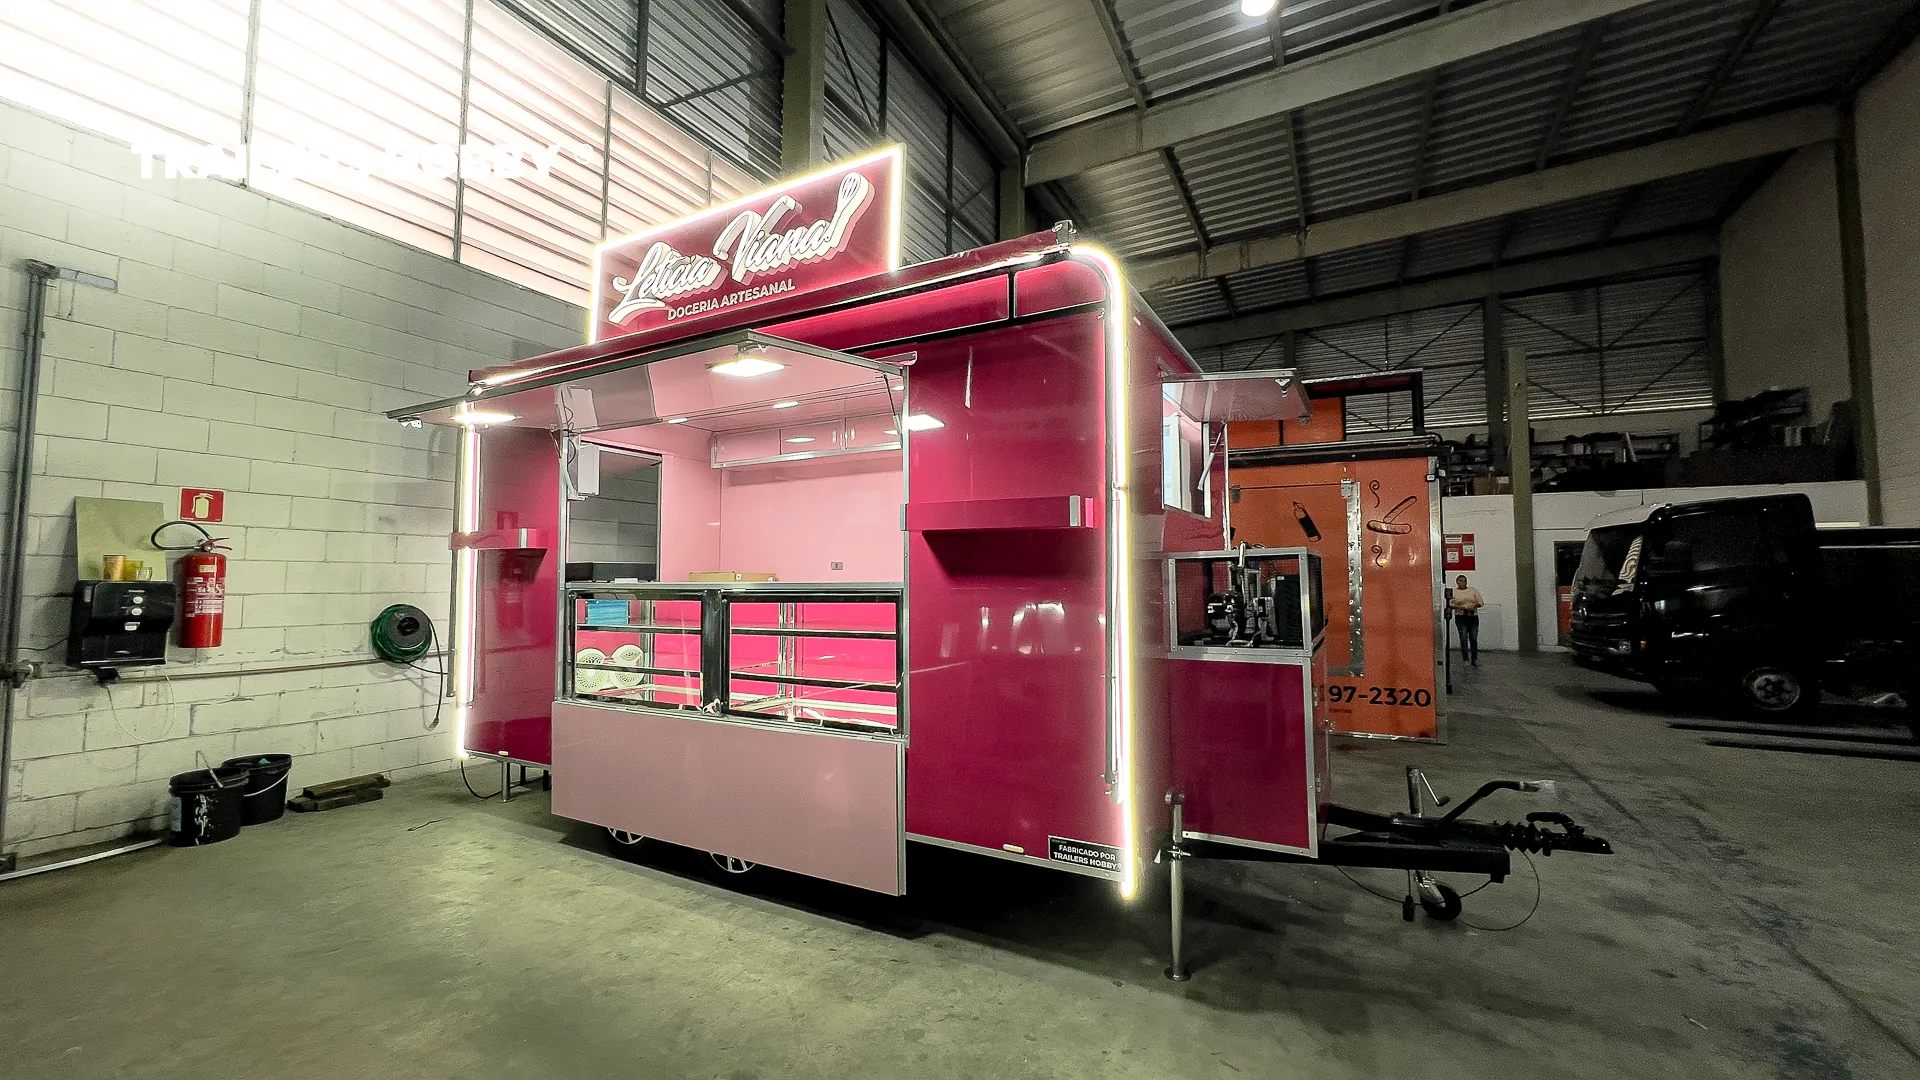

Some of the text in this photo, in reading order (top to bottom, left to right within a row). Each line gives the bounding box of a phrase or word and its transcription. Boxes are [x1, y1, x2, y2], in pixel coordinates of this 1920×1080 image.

[713, 172, 866, 284] Viana
[667, 278, 796, 321] DOCERIA ARTESANAL
[1053, 852, 1088, 864] TRAILERS
[1059, 845, 1115, 861] FABRICADO POR
